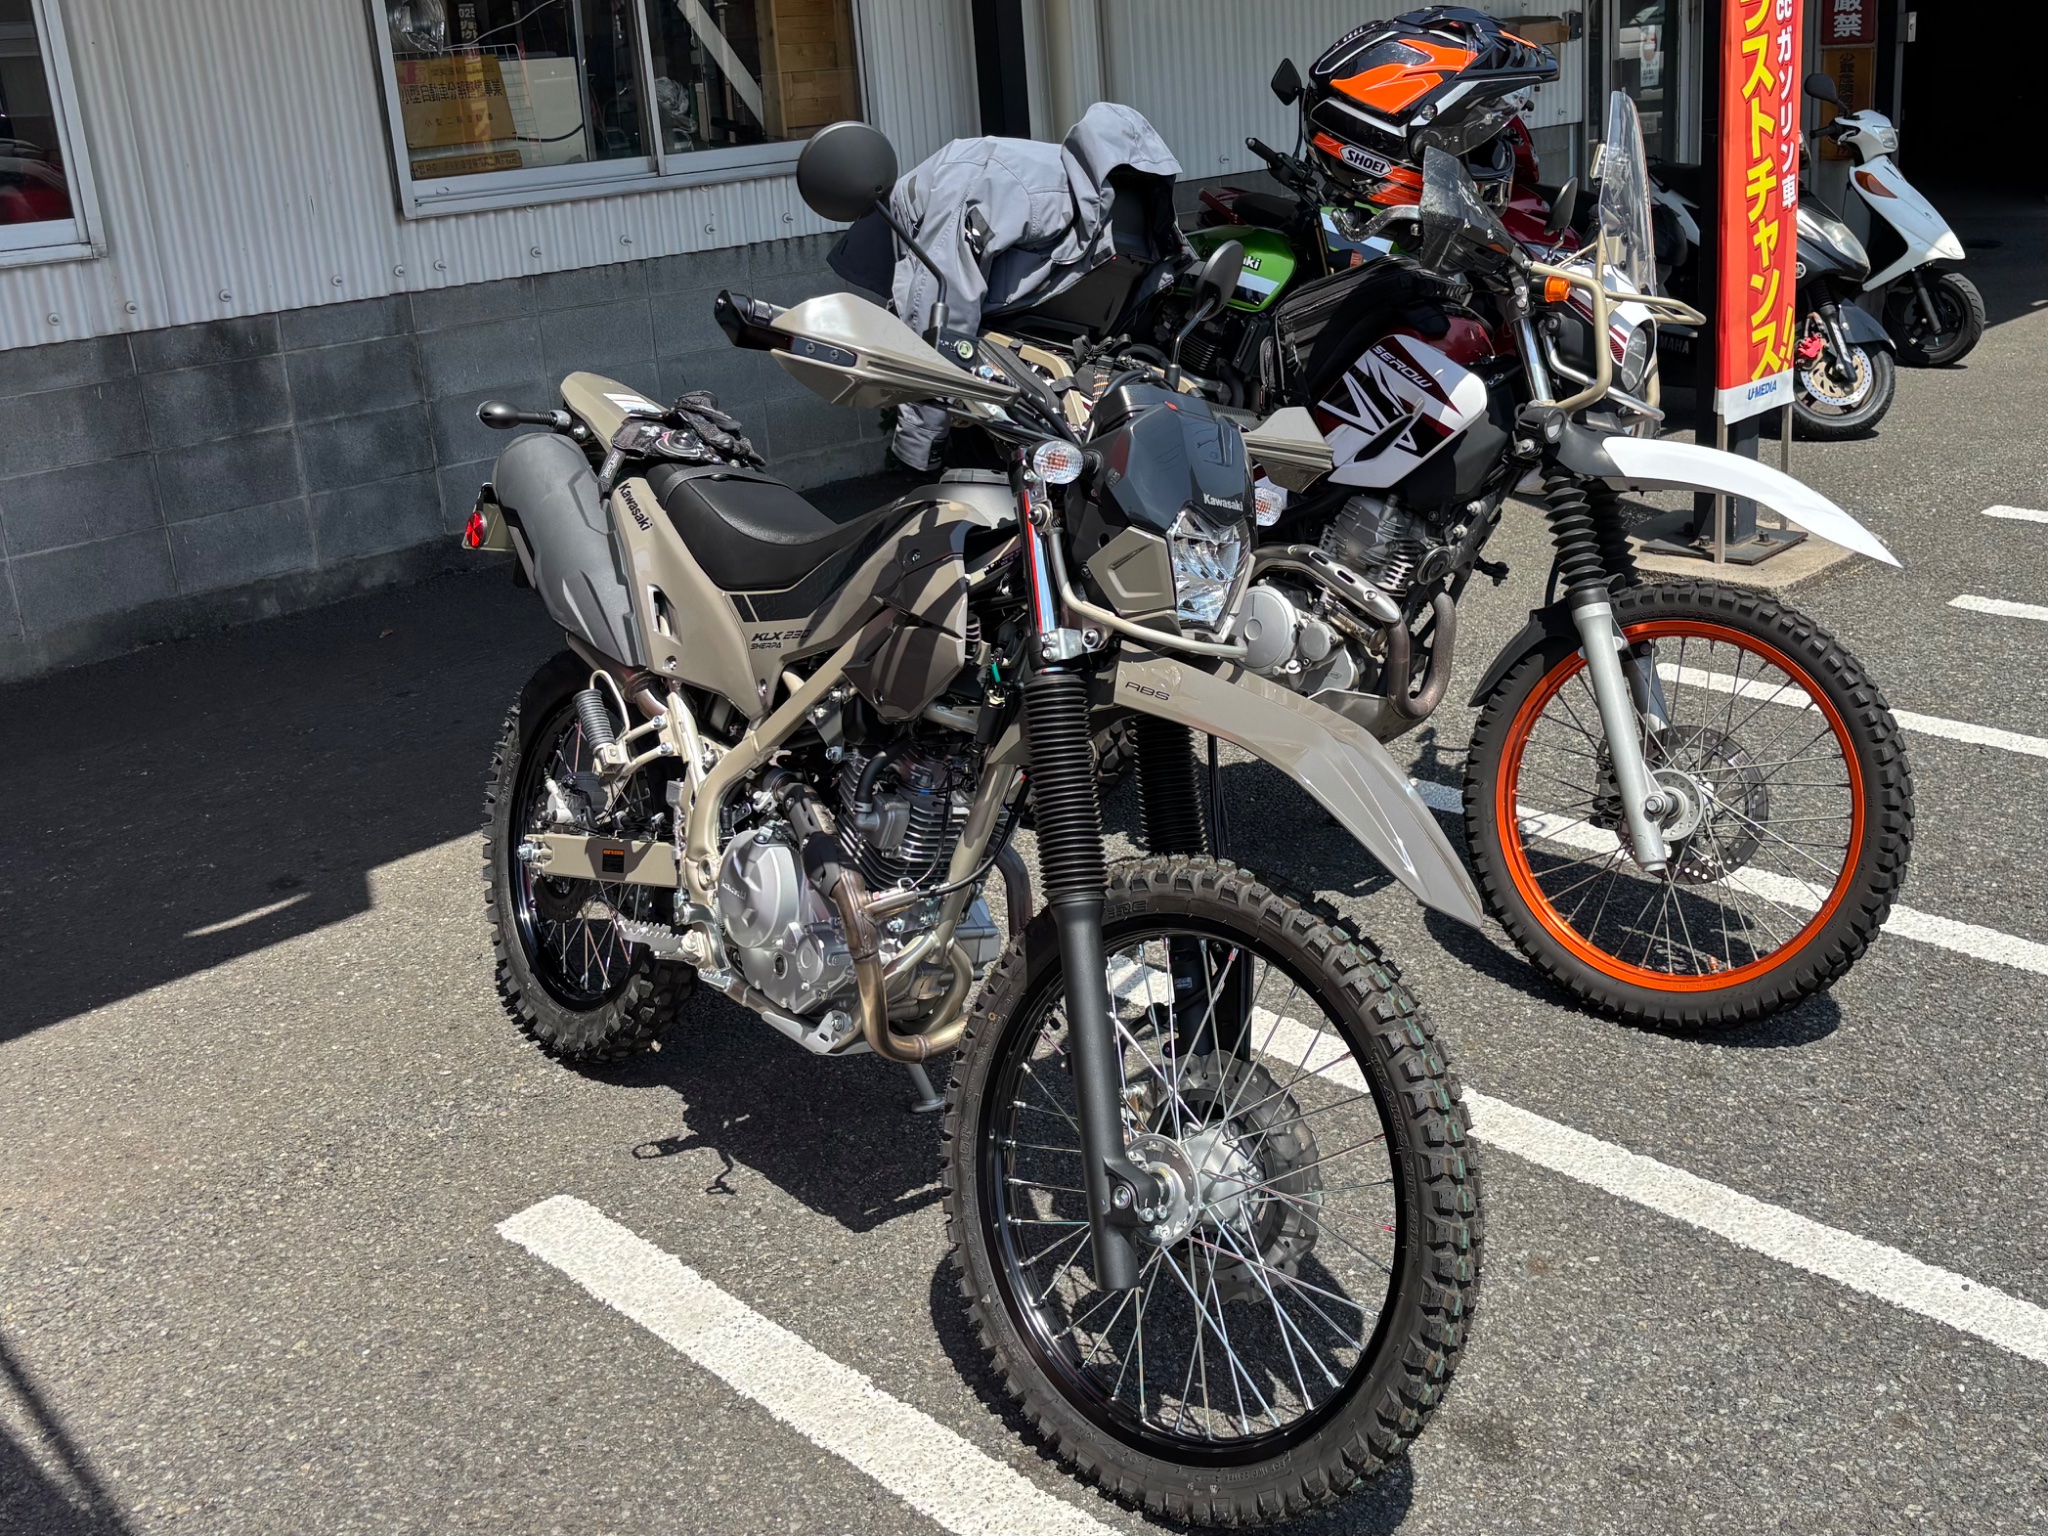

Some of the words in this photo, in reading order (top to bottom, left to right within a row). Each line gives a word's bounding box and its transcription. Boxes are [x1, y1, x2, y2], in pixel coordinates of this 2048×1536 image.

[1346, 149, 1386, 174] SHOEI
[1372, 345, 1432, 388] SEROW
[1747, 379, 1777, 401] U-MEDIA
[618, 482, 653, 531] Kawasaki
[1203, 493, 1244, 512] Kawasaki
[750, 641, 783, 650] SHERPA
[751, 631, 784, 641] KLX
[783, 629, 812, 640] 230
[1125, 681, 1171, 701] ABS
